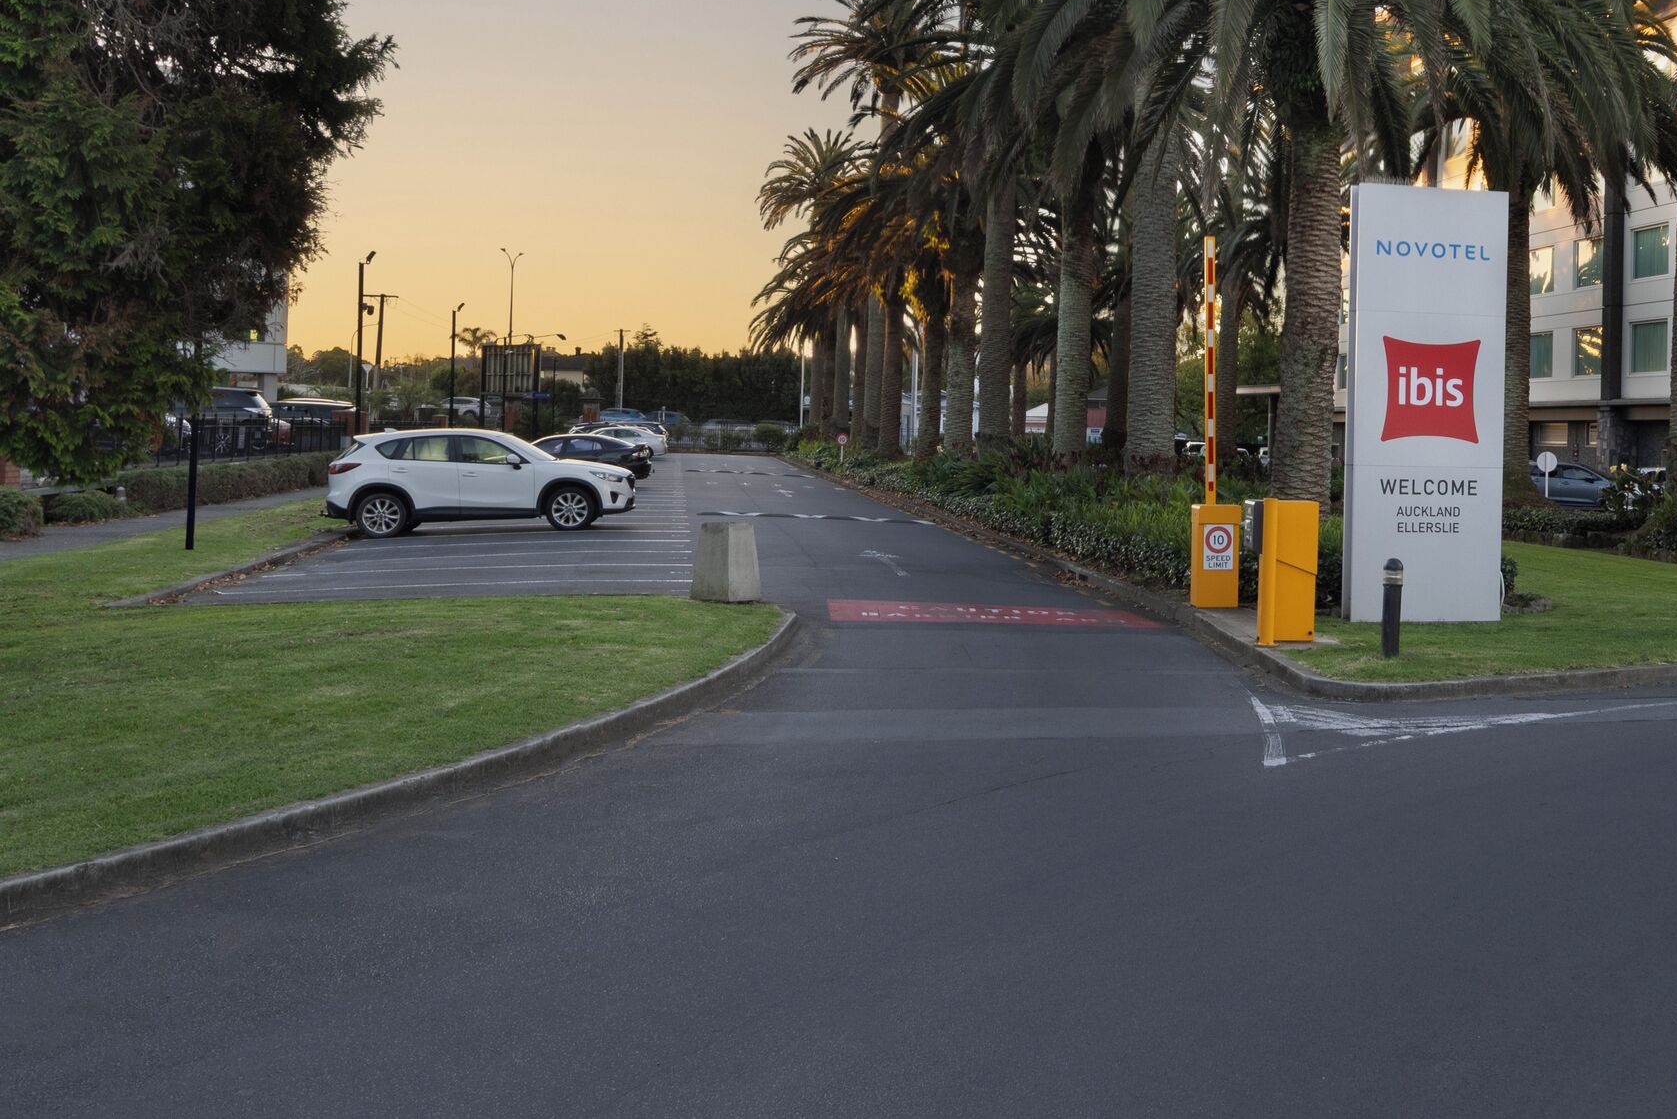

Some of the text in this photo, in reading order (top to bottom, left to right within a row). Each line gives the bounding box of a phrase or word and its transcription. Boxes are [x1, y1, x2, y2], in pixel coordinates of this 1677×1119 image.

[1376, 239, 1490, 260] NOVOTEL
[1398, 366, 1464, 407] ibis
[1380, 478, 1478, 496] WELCOME
[1396, 506, 1461, 517] AUCKLAND
[1397, 522, 1460, 534] ELLERSLIE
[1213, 535, 1224, 545] 10
